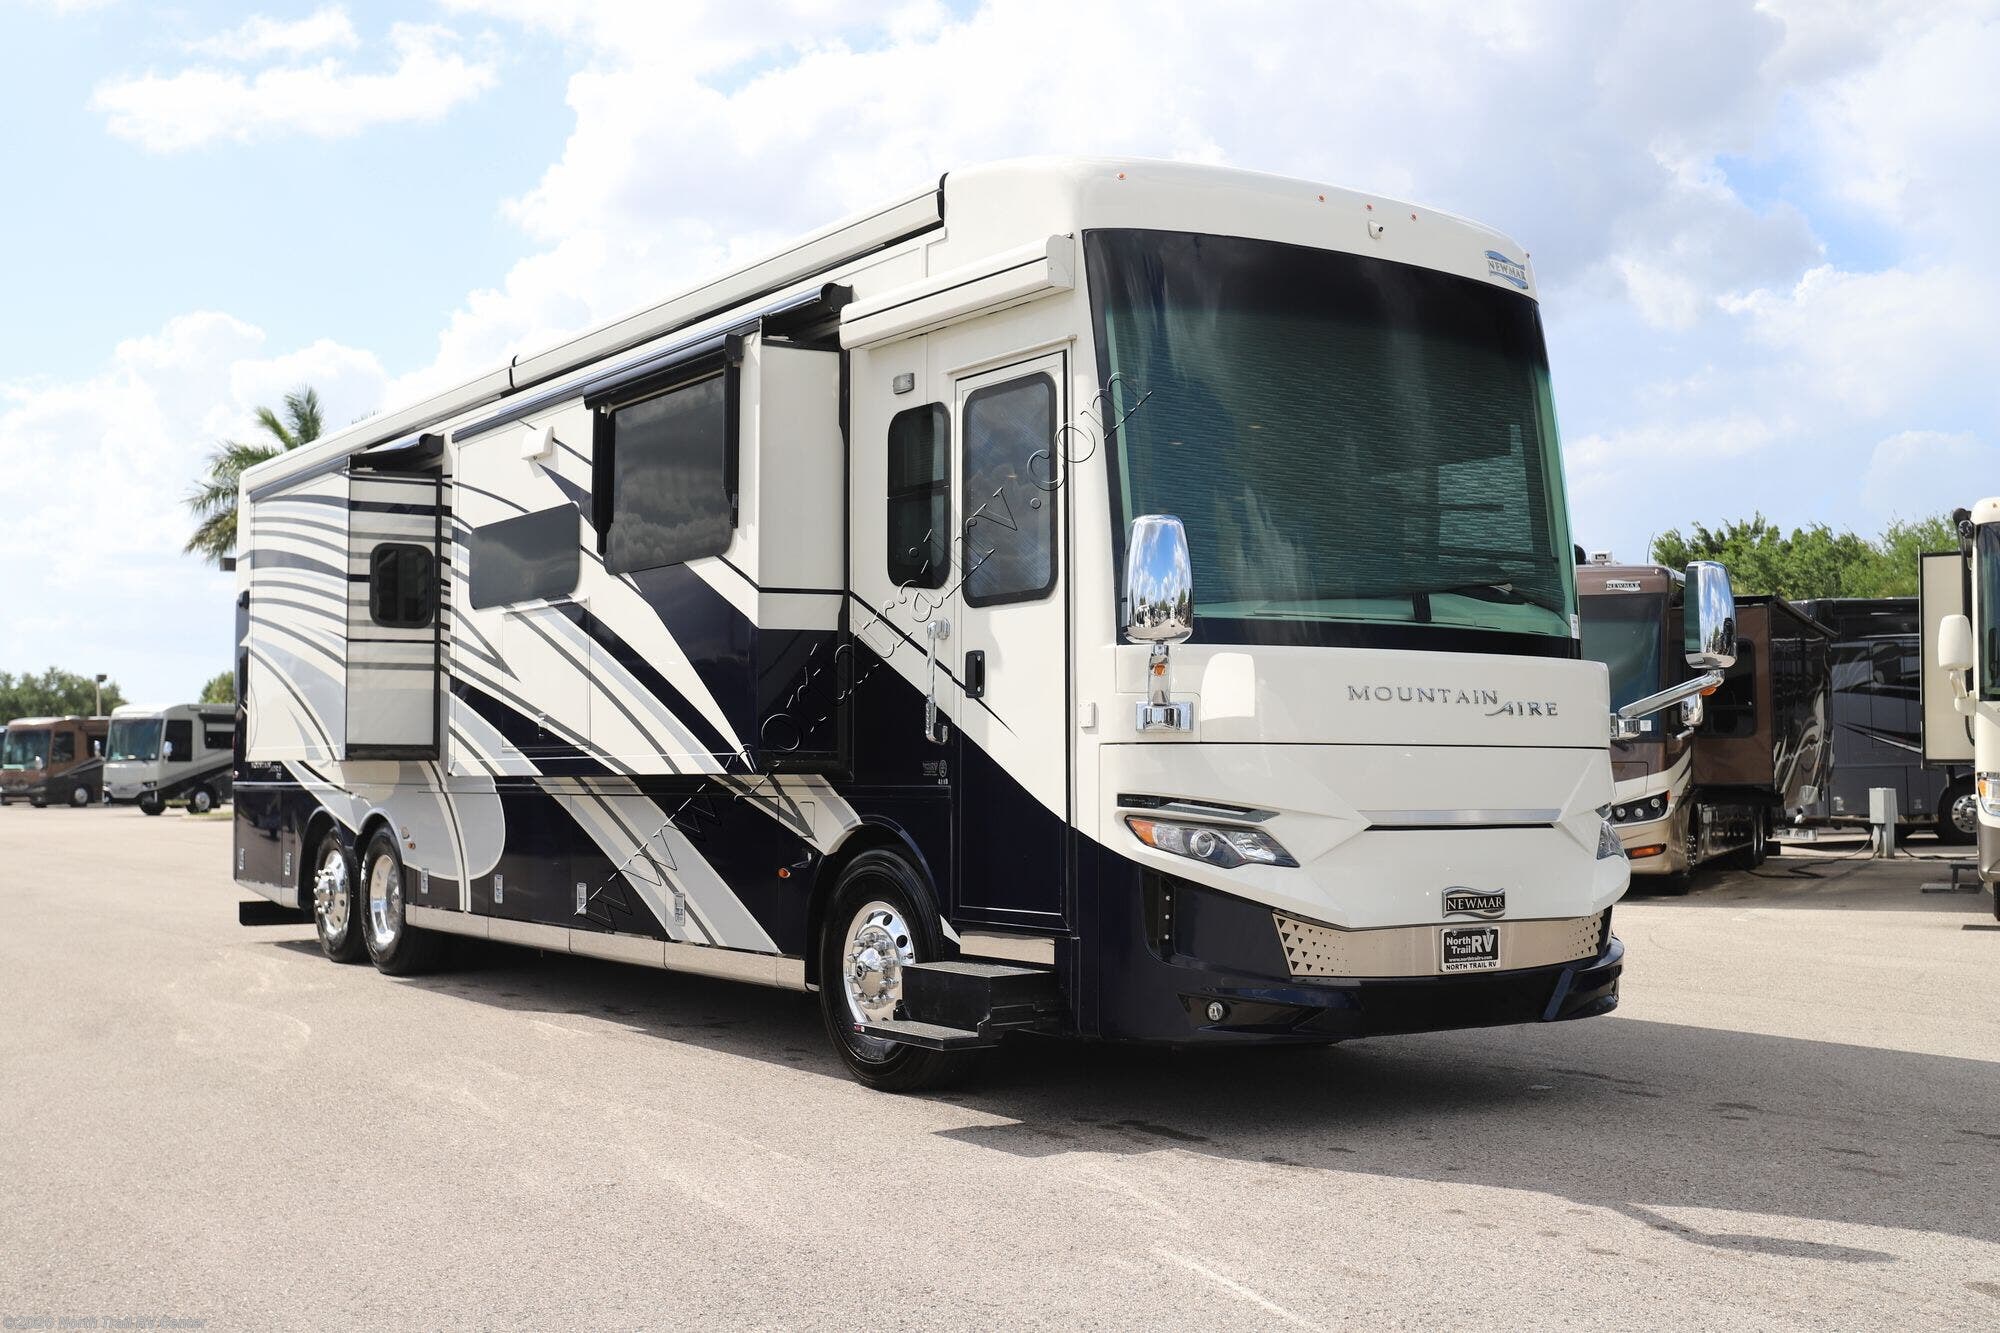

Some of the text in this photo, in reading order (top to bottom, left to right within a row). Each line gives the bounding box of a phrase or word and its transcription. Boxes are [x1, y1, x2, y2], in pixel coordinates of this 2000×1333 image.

[1488, 260, 1527, 281] NEWMAR
[1347, 685, 1558, 716] MOUNTAIN AIRE
[1447, 897, 1504, 910] NEWMAR
[1446, 936, 1471, 946] North
[1472, 935, 1494, 952] RV
[1451, 945, 1471, 954] Trail
